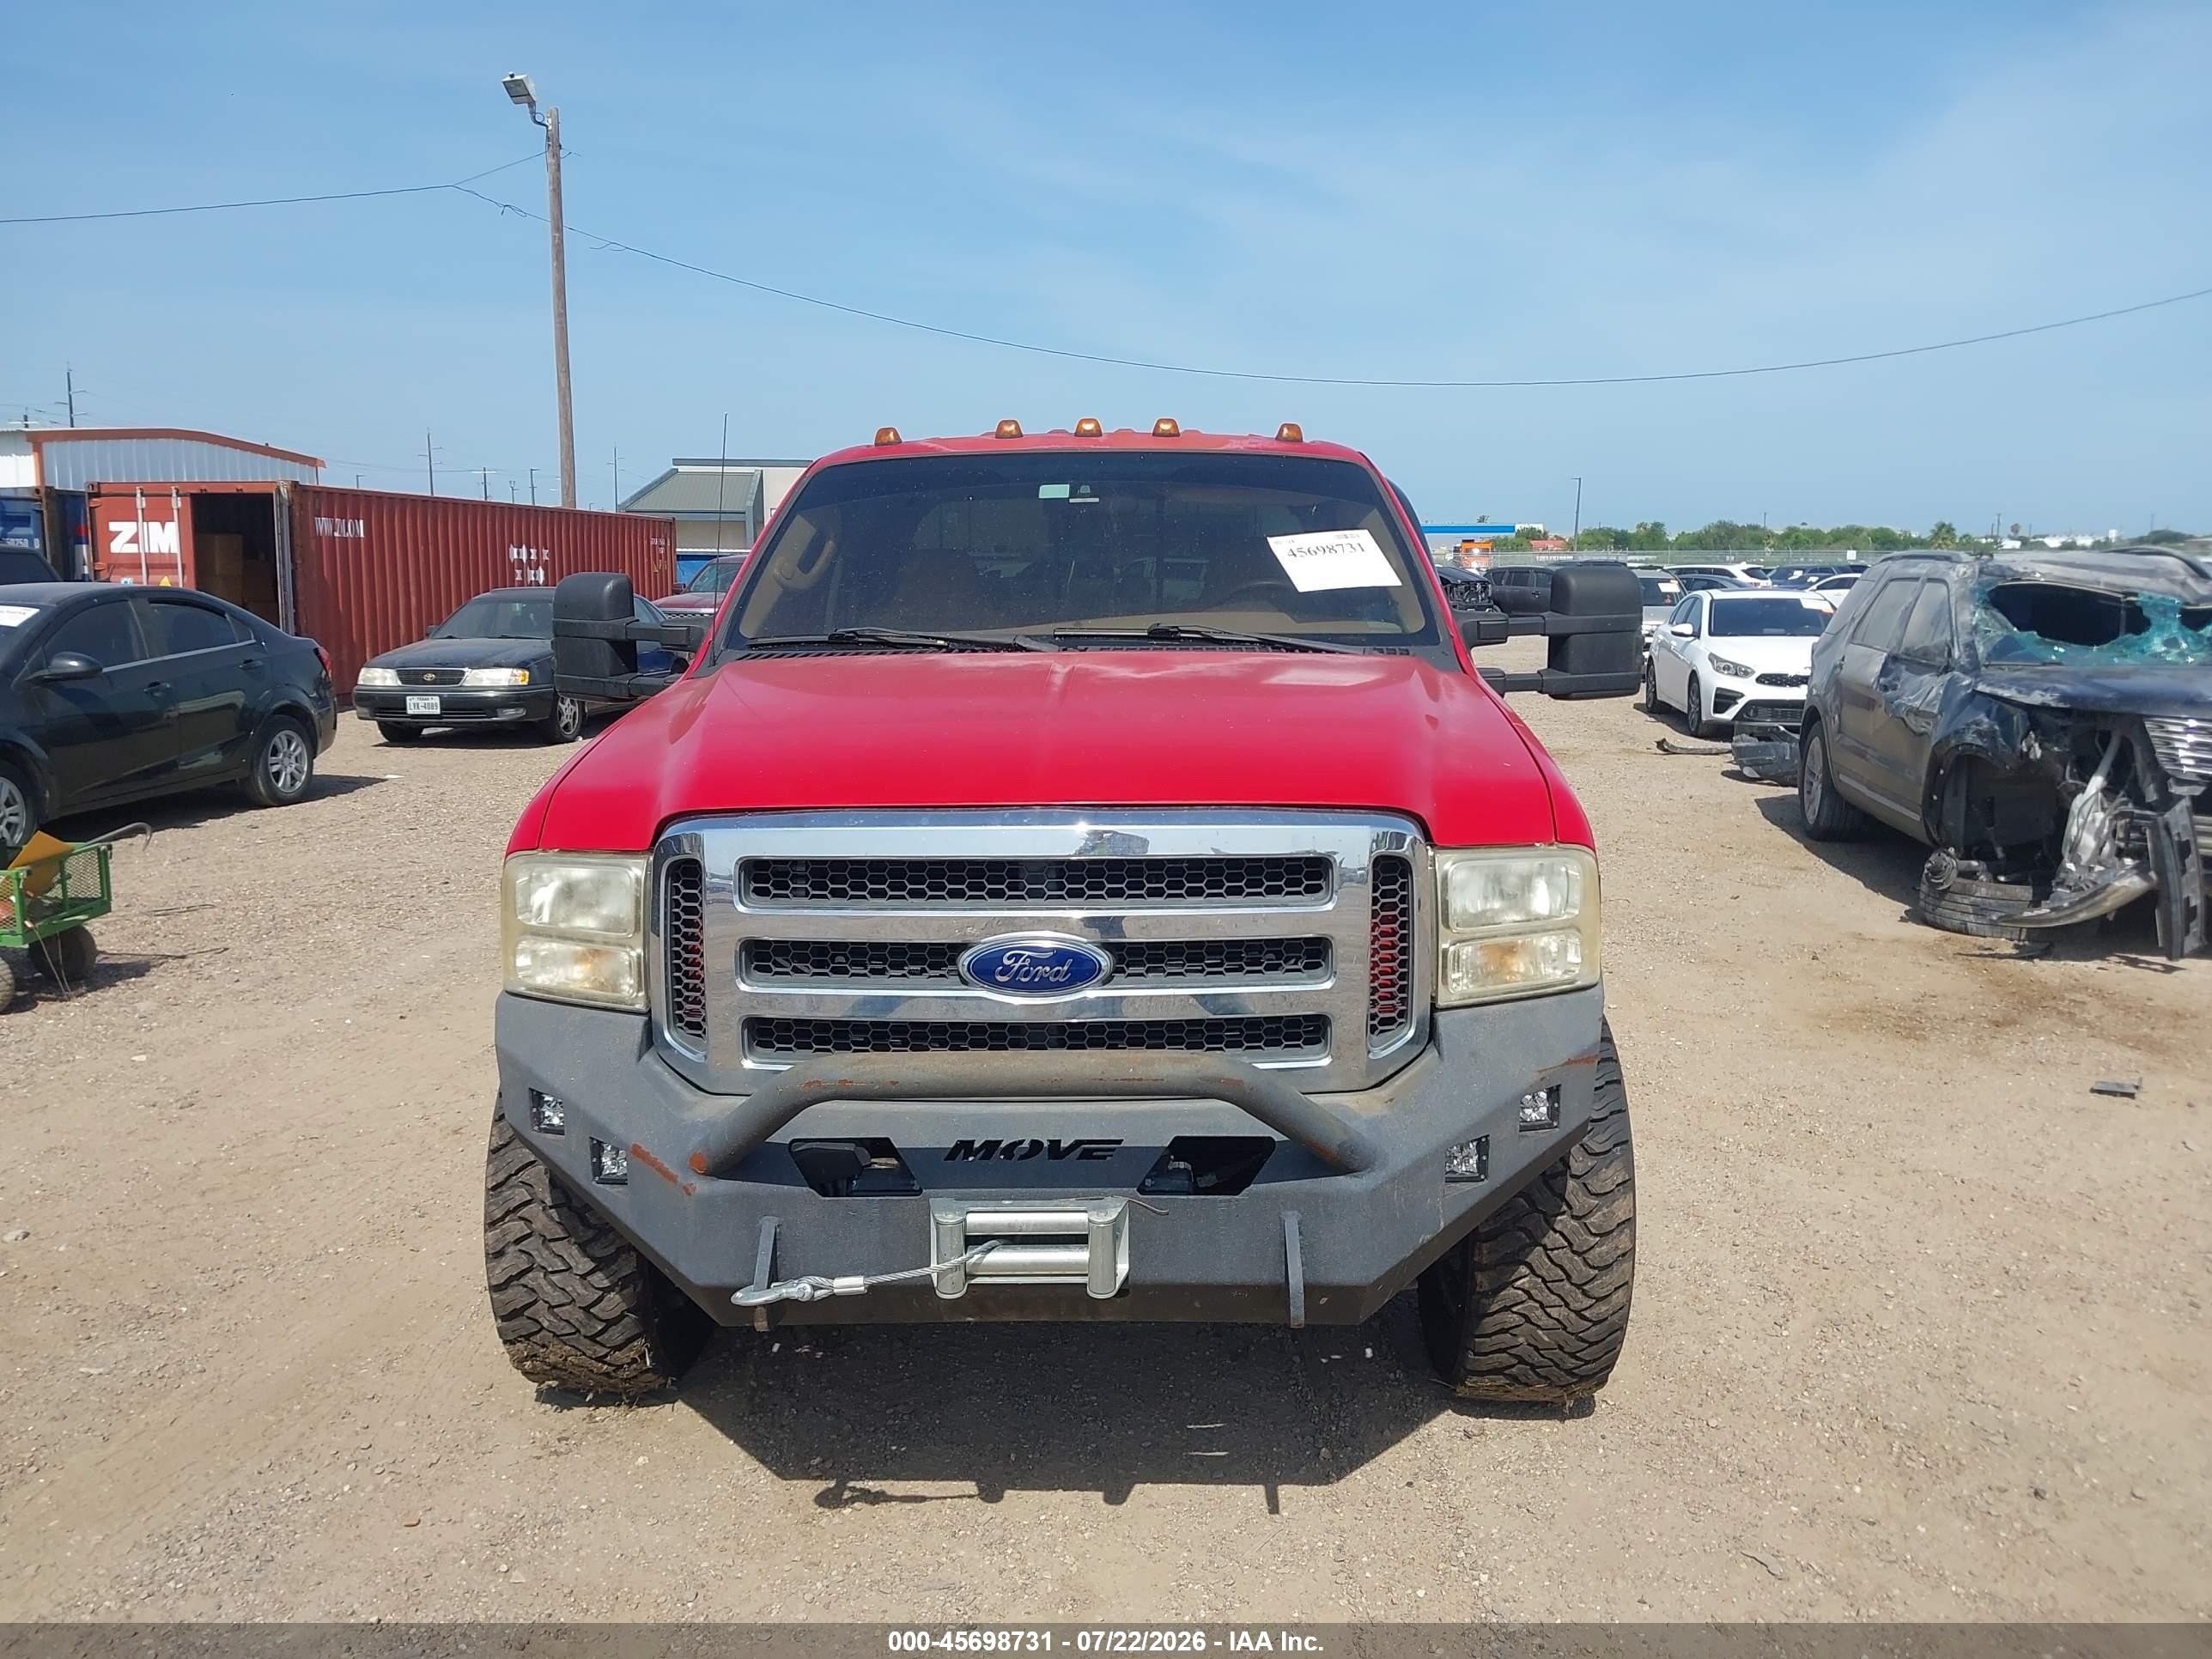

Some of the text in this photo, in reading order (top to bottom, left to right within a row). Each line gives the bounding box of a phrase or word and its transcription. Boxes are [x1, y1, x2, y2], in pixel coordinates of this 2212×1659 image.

[108, 521, 179, 554] ZIM
[1287, 542, 1365, 558] 45698731
[994, 950, 1073, 983] Ford
[945, 1139, 1124, 1161] MOVE
